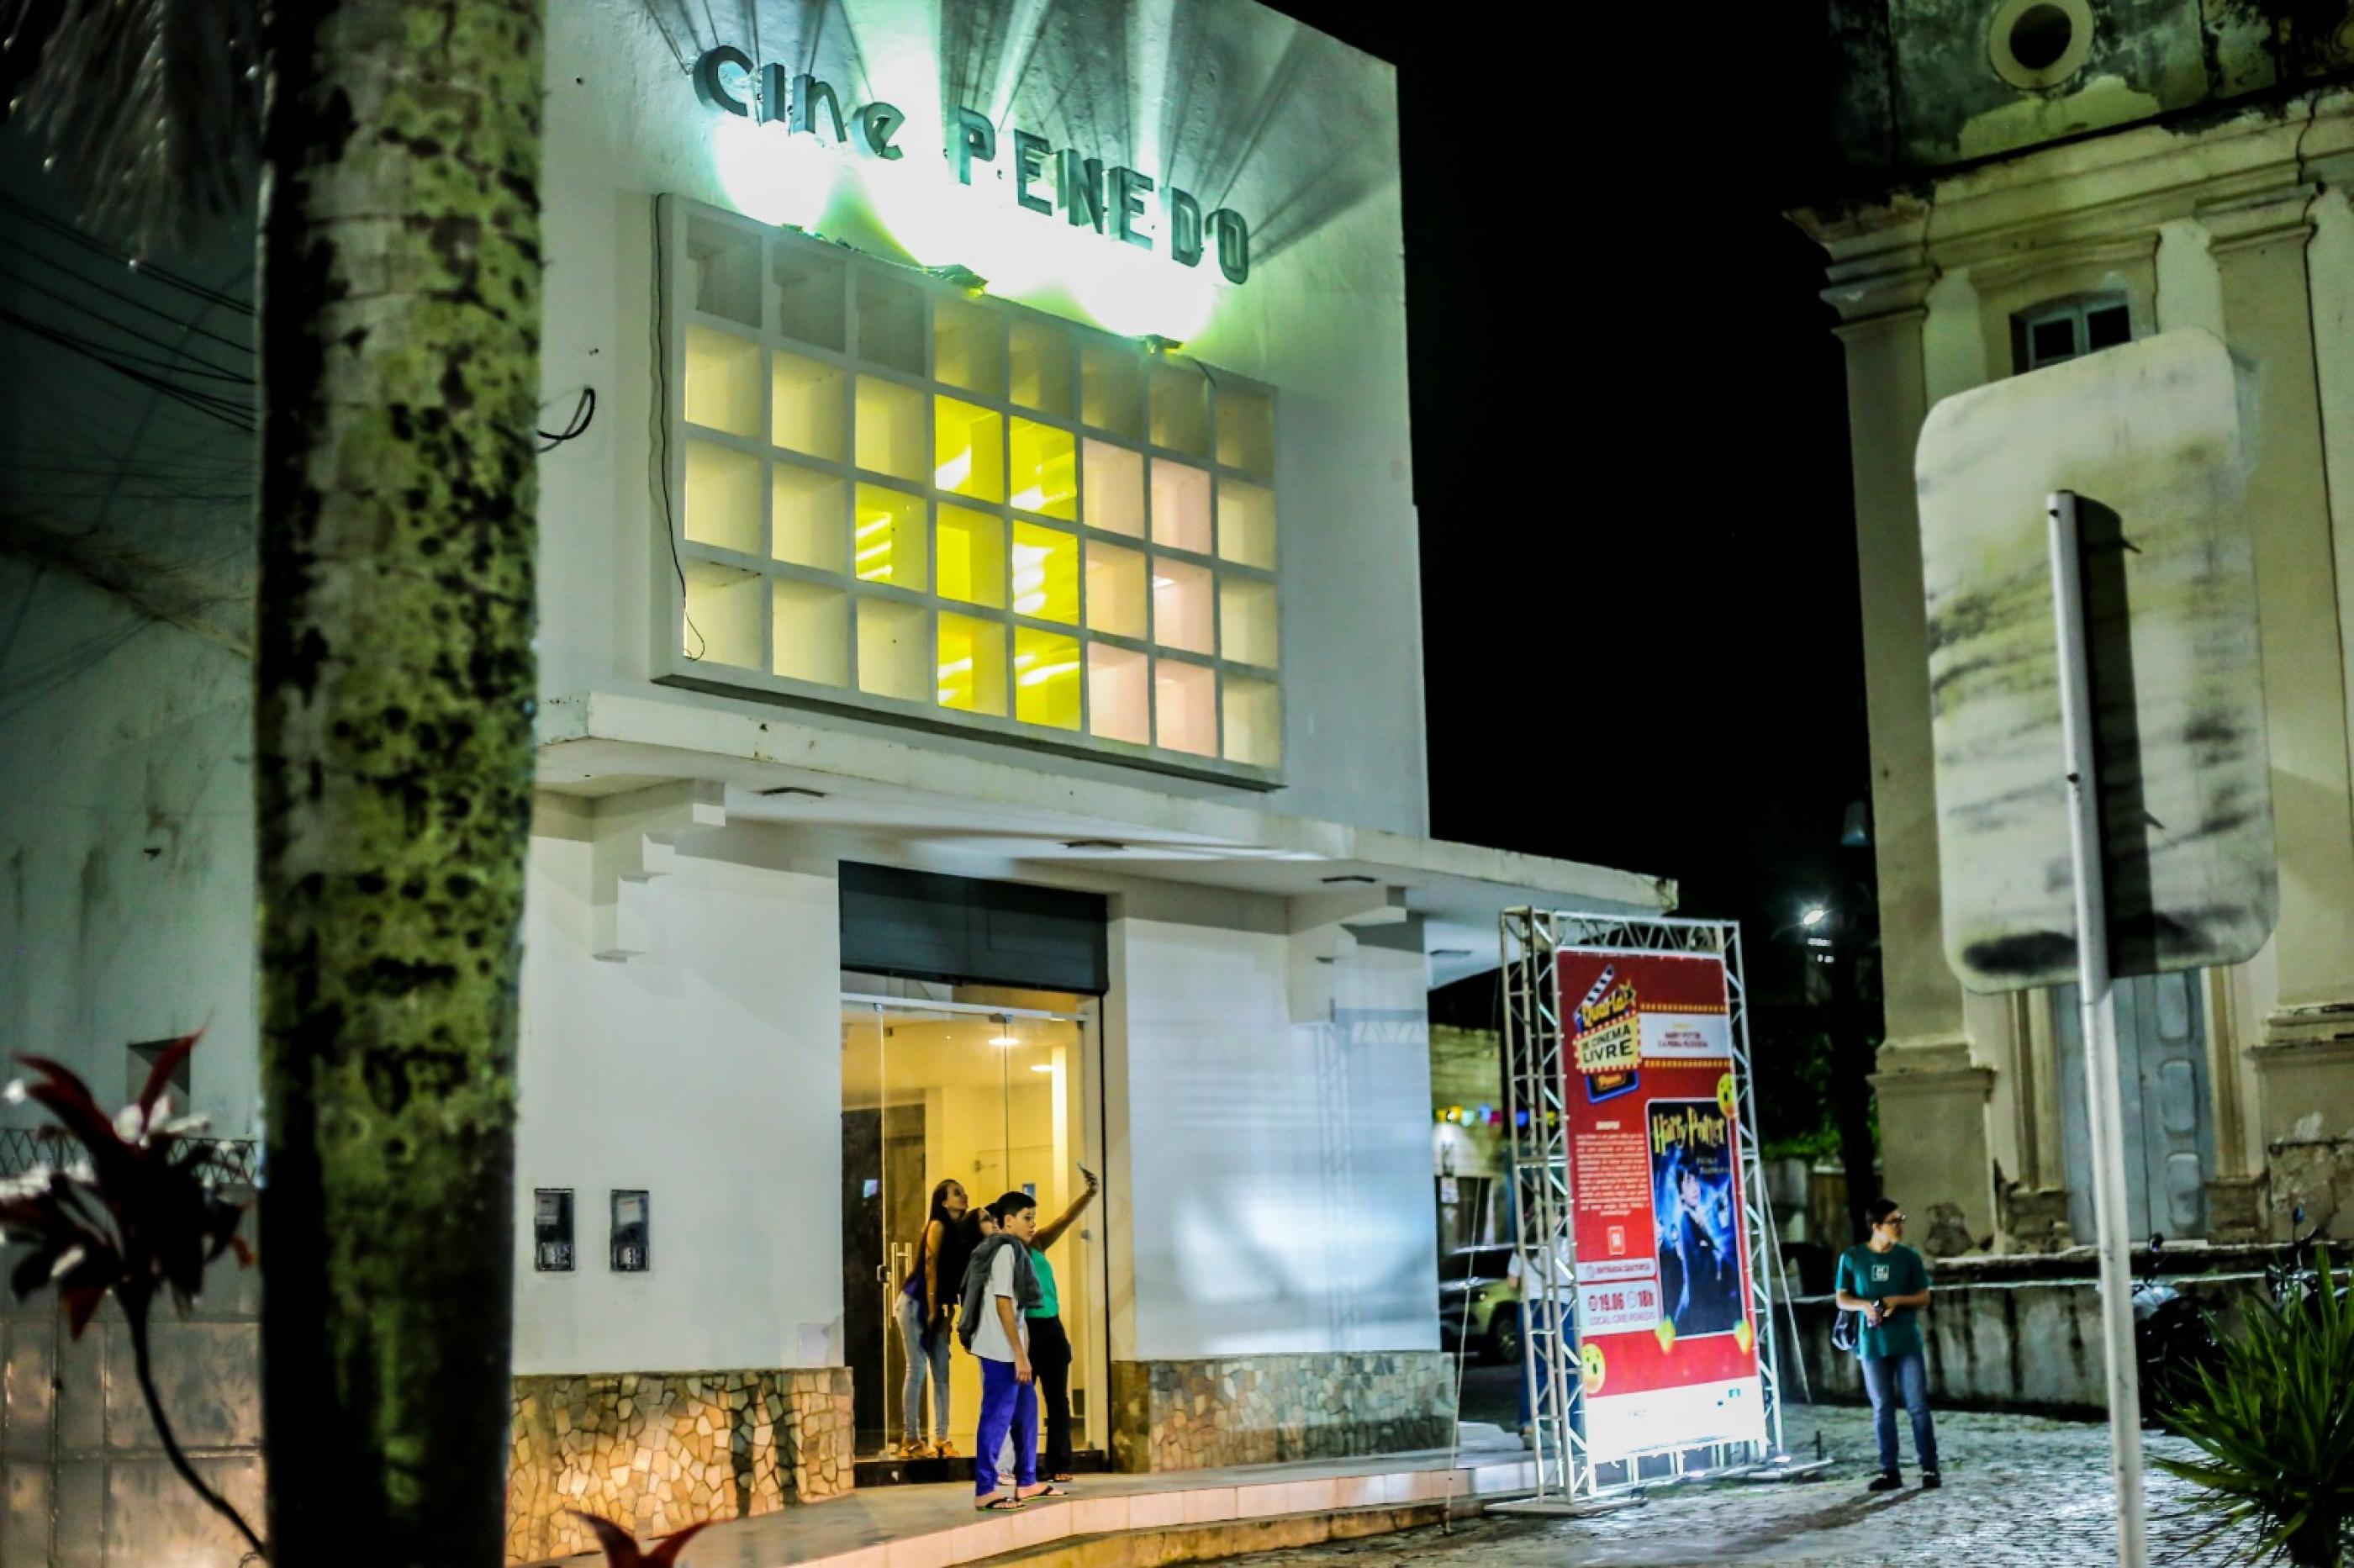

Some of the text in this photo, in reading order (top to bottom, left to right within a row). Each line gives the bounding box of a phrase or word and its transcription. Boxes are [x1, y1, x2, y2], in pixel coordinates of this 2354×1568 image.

[952, 105, 1250, 285] PENEDO
[1591, 1023, 1631, 1046] CINEMA
[1582, 1038, 1634, 1064] LIVRE
